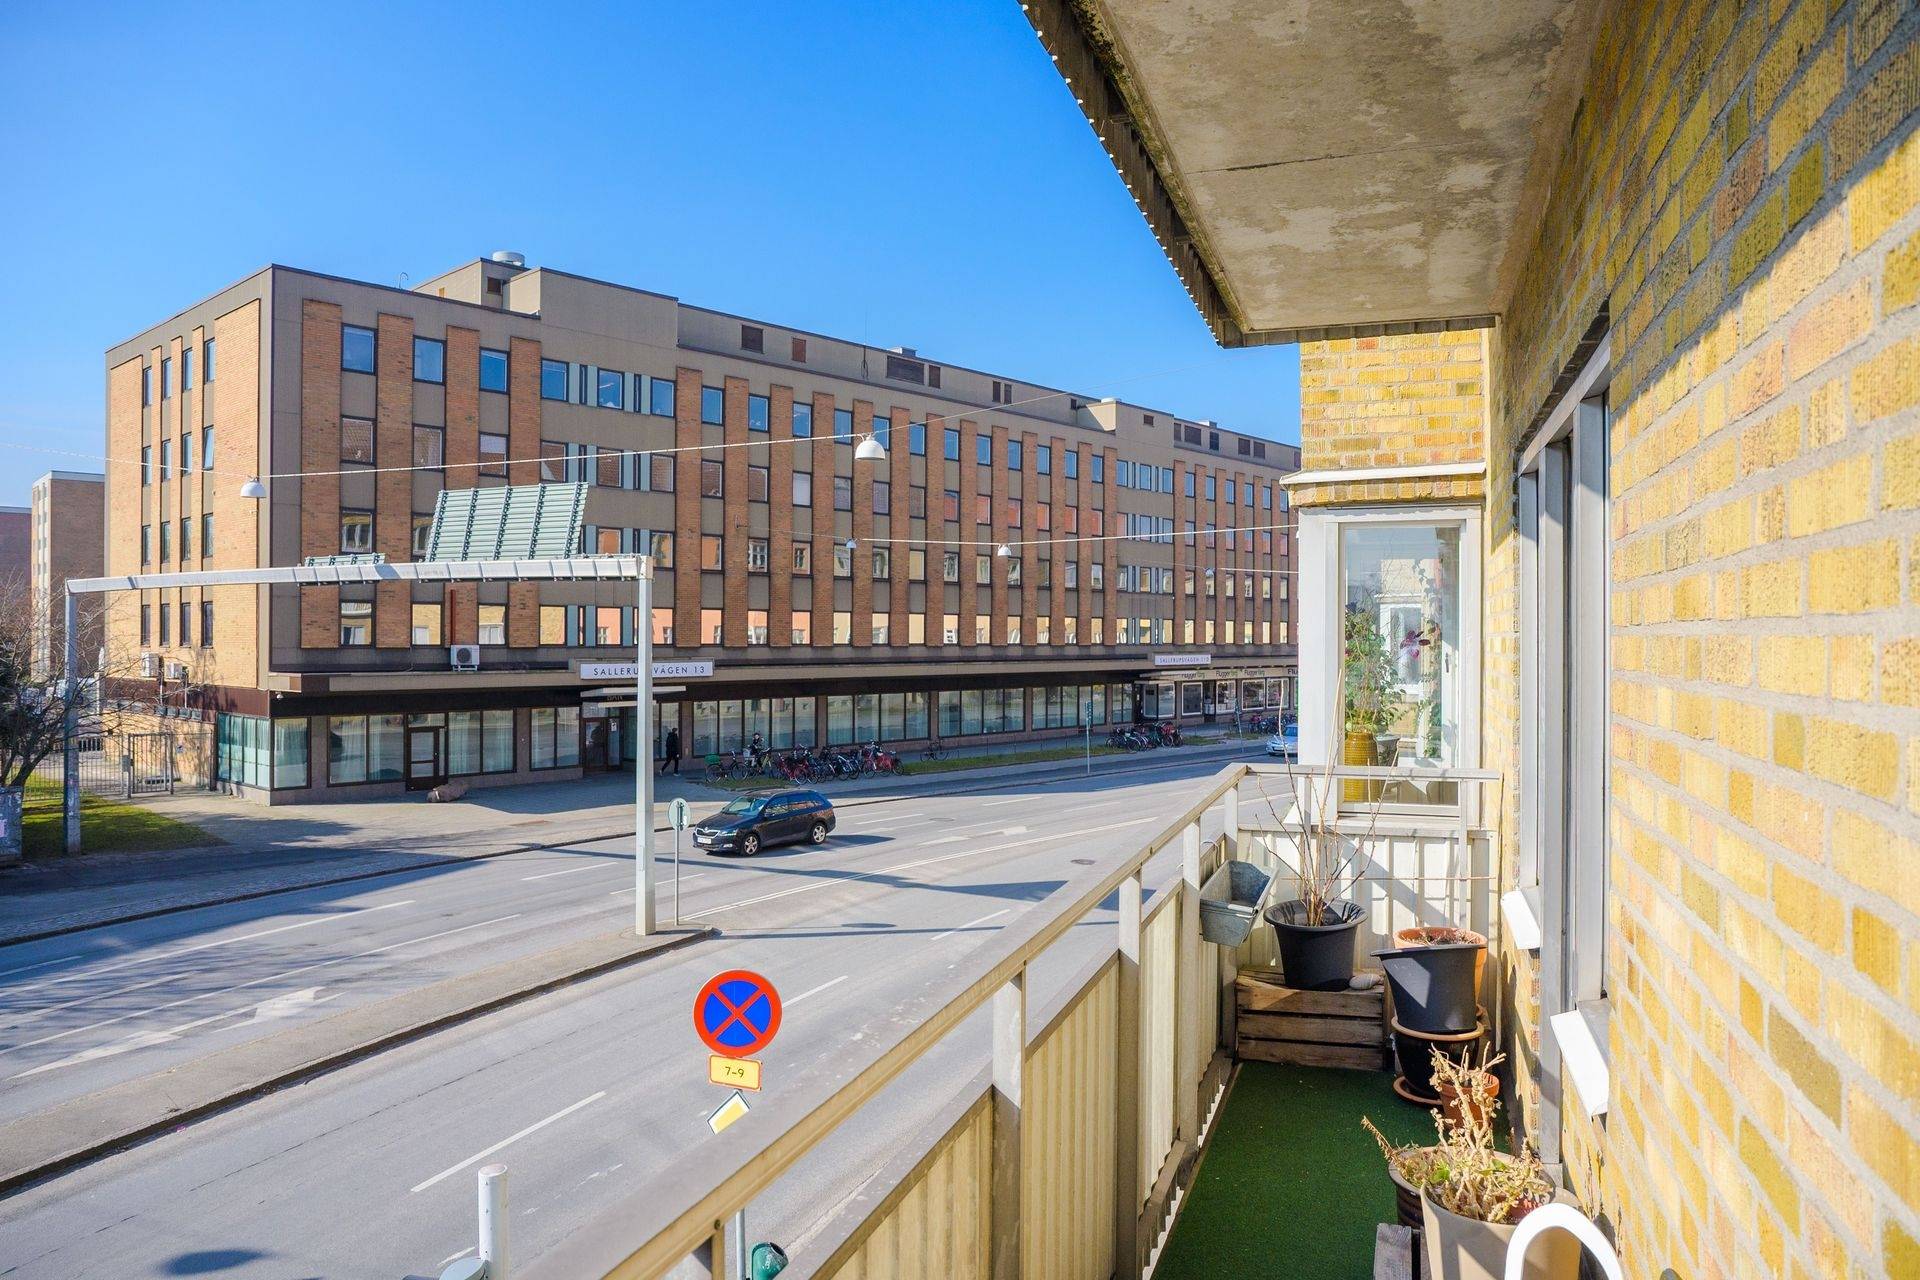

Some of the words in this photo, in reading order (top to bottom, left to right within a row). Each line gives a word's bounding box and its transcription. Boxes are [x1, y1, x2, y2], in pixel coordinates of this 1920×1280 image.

[593, 665, 688, 676] SALLERUVÄGEN
[694, 665, 705, 674] 13
[725, 1066, 744, 1078] 7-9
